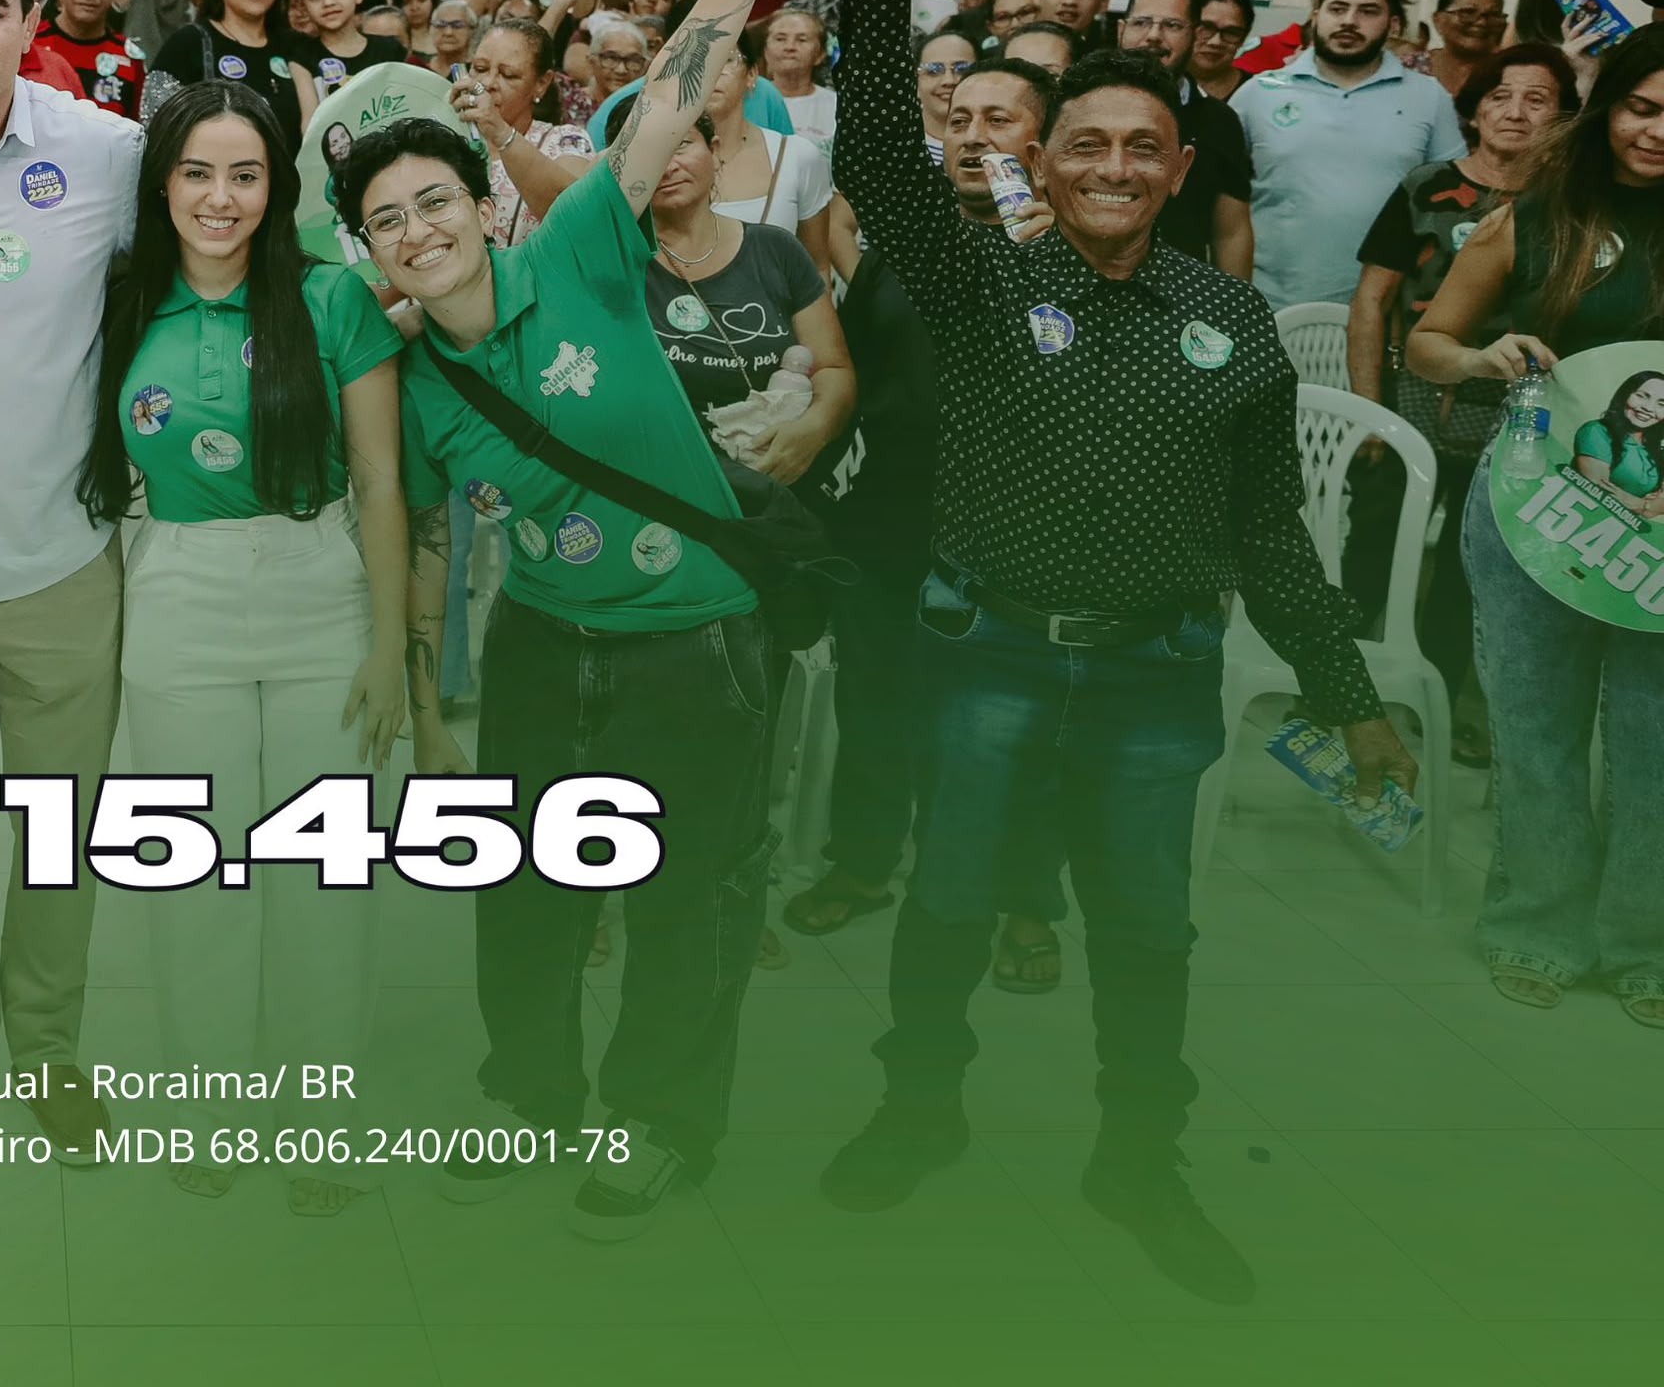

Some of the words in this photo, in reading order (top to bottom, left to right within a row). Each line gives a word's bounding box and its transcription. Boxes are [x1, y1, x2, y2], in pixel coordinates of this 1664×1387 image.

[26, 170, 58, 184] DANIEL
[27, 178, 60, 189] TRINDADE
[27, 184, 64, 202] 2222
[541, 346, 594, 395] Sulielma
[702, 353, 748, 369] amor
[753, 352, 780, 371] por
[149, 399, 169, 413] 555
[1561, 466, 1604, 501] DEPUTADA
[1602, 496, 1642, 532] ESTADUAL
[559, 522, 588, 539] DANIEL
[562, 533, 599, 557] 2222
